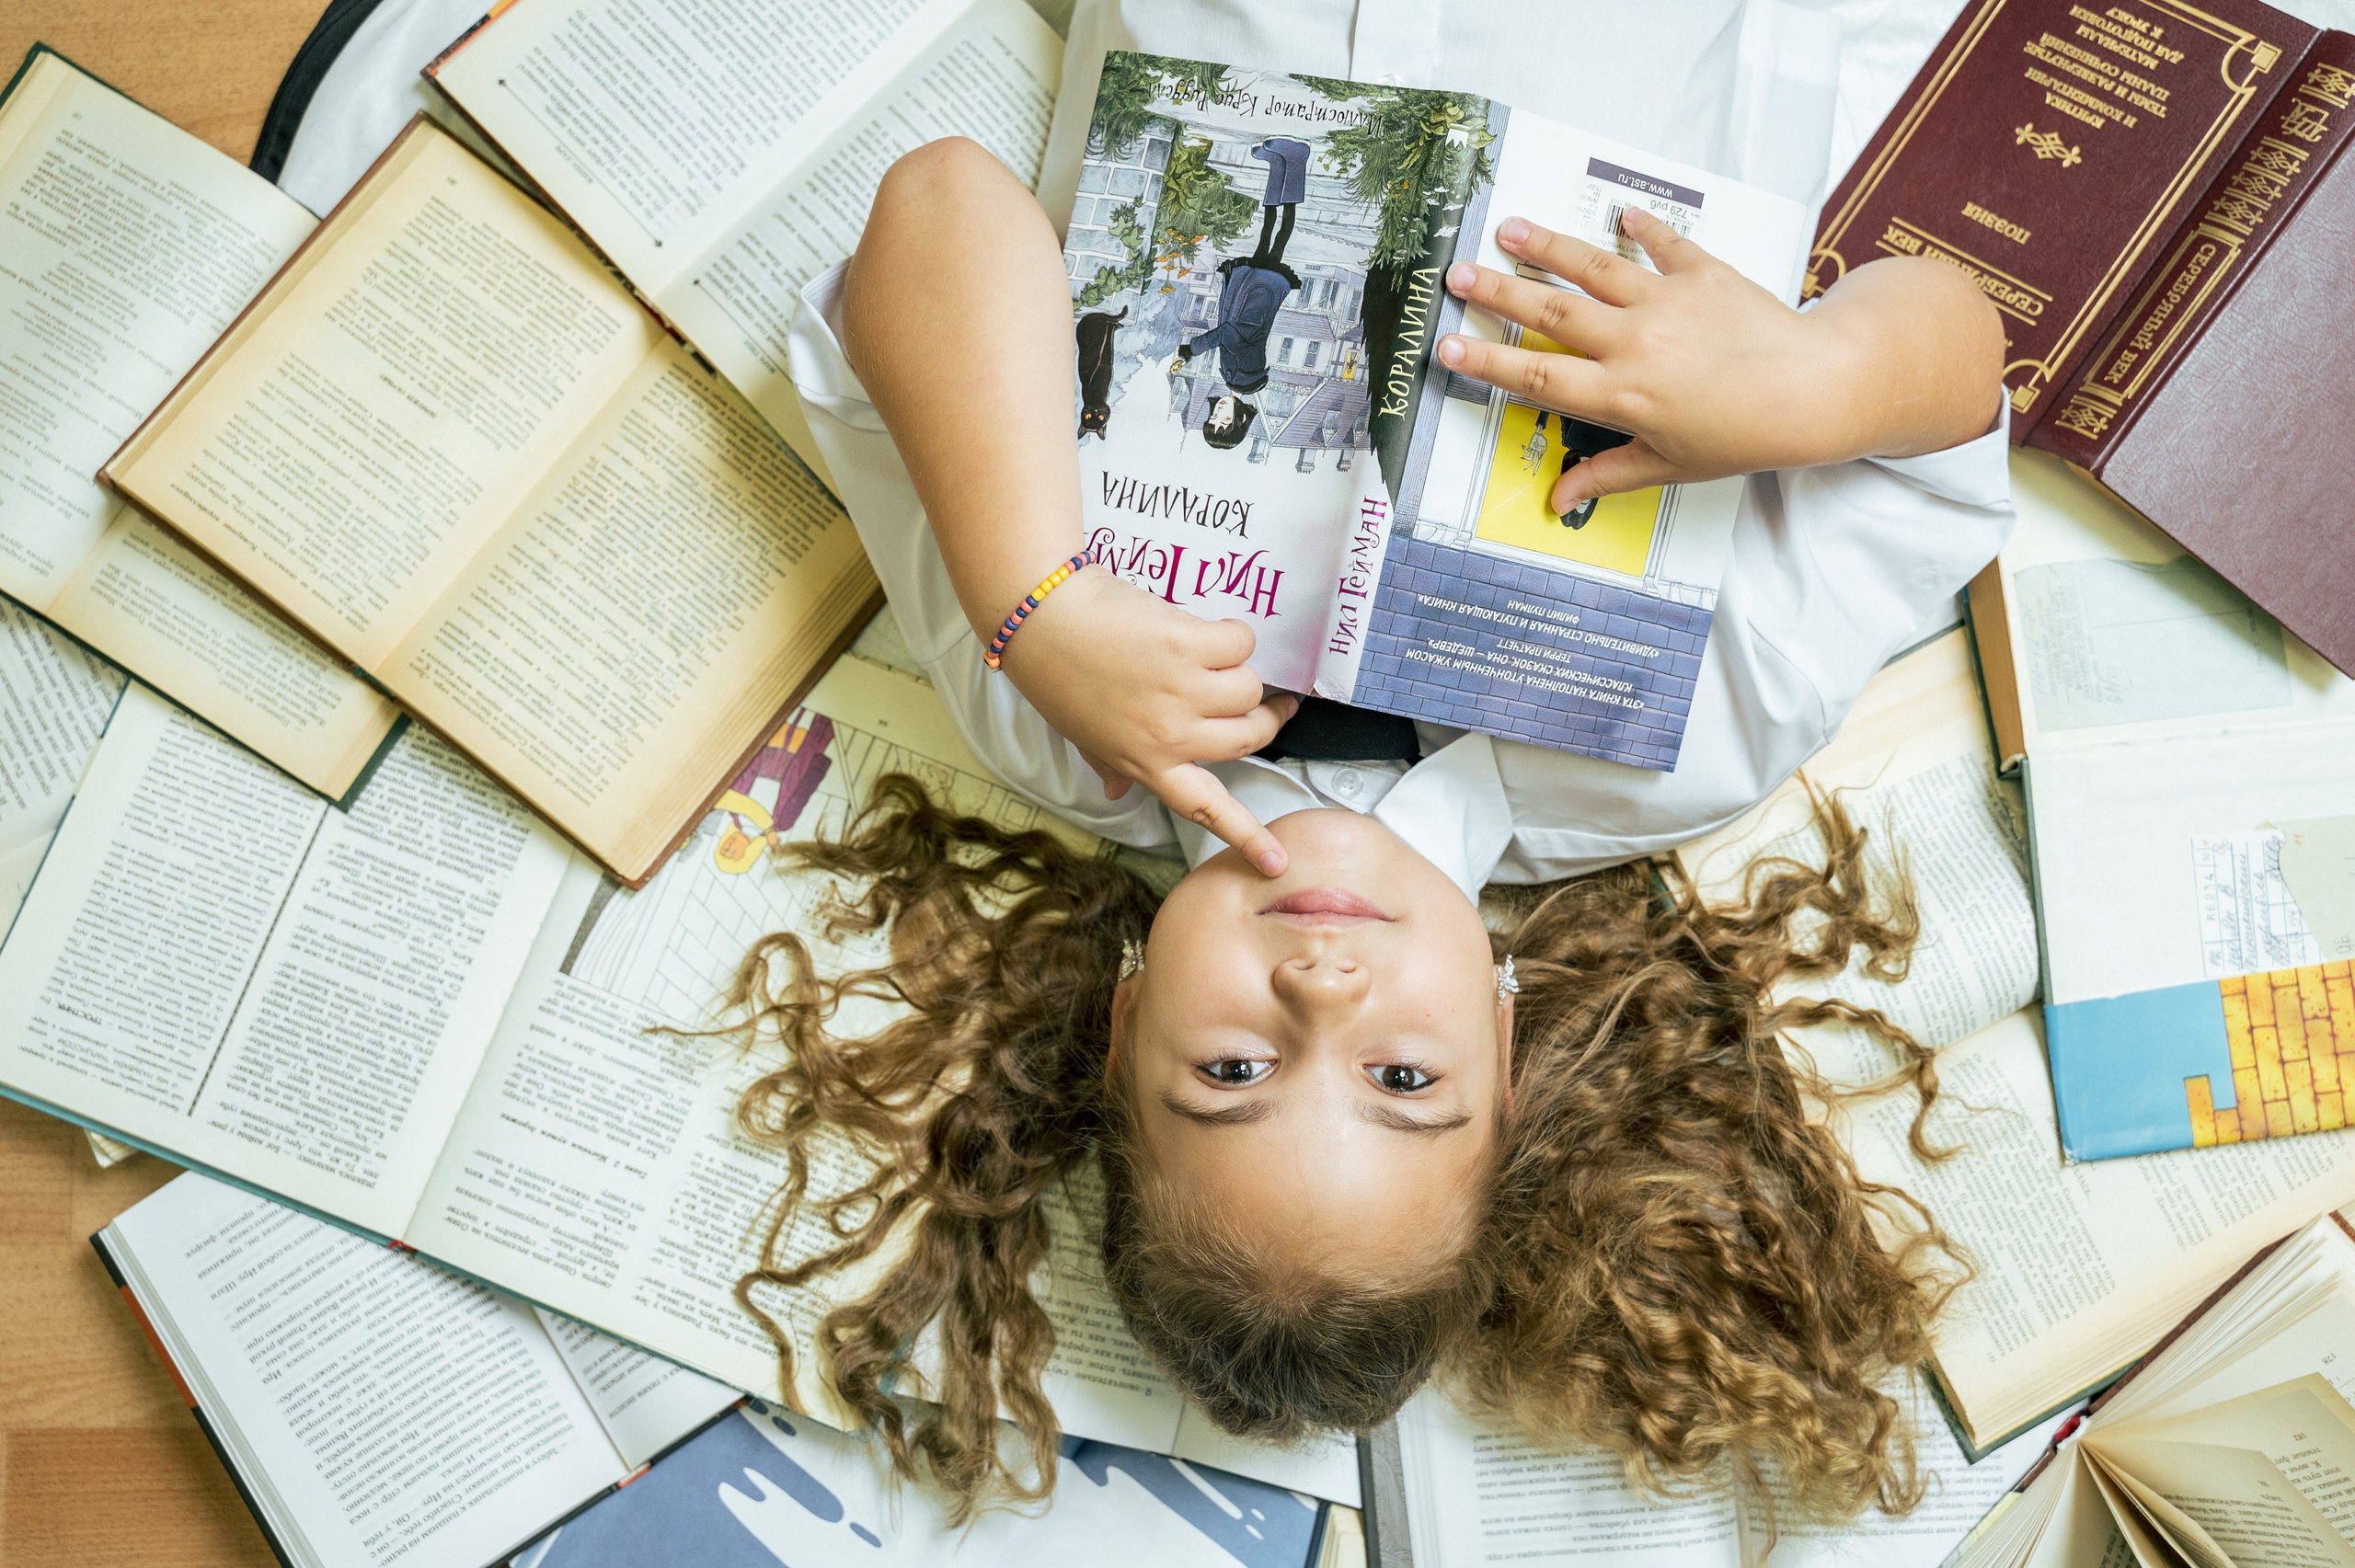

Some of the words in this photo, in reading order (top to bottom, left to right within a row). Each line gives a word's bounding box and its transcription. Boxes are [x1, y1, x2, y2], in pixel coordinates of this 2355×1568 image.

[2068, 4, 2155, 52] ПОДГОТОВКИ
[2105, 6, 2151, 33] УРОКУ
[2149, 25, 2164, 39] К
[2039, 31, 2120, 76] СОЧИНЕНИЙ
[2074, 24, 2159, 70] МАТЕРИАЛЫ
[2154, 44, 2184, 63] ДЛЯ
[2023, 40, 2116, 91] РАЗВЕРНУТЫЕ
[2024, 66, 2124, 121] КОММЕНТАРИИ
[2113, 84, 2129, 98] И
[2119, 70, 2170, 101] ПЛАНЫ
[2044, 91, 2105, 129] КРИТИКА
[2126, 90, 2166, 118] ТЕМЫ
[1265, 94, 1383, 139] Иллюстратор
[2121, 113, 2137, 128] И
[1617, 173, 1672, 198] www.ast.ru
[1648, 199, 1668, 210] руб.
[1670, 205, 1687, 219] 729
[1960, 200, 2031, 244] ПОЭЗИЯ
[1882, 225, 1923, 255] ВЕК
[2129, 243, 2216, 350] СЕРЕБРЯНЫЙ
[2104, 349, 2138, 383] ВЕК
[1417, 593, 1457, 611] КНИГА».
[1507, 600, 1545, 616] ПУЛМАН
[1457, 603, 1518, 625] ПУГАЮЩАЯ
[1519, 617, 1528, 627] И
[1545, 609, 1579, 624] ФИЛИП
[1529, 620, 1582, 640] СТРАННАЯ
[1428, 637, 1475, 657] ШЕДЕВР».
[1496, 638, 1542, 656] ПРАТЧЕТТ
[1584, 633, 1659, 658] «УДИВИТЕЛЬНО
[1405, 647, 1452, 667] УЖАСОМ
[1487, 651, 1508, 664] ОНА
[1511, 656, 1553, 674] СКАЗОК,
[1542, 649, 1570, 663] ТЕРРИ
[1452, 658, 1524, 682] УТОНЧЕННЫМ
[1554, 667, 1632, 692] КЛАССИЧЕСКИХ
[1526, 675, 1587, 697] НАПОЛНЕНА
[1589, 689, 1621, 704] КНИГА
[1622, 696, 1644, 709] «ЭТА
[2321, 1352, 2336, 1365] 178
[2292, 1432, 2307, 1441] 182
